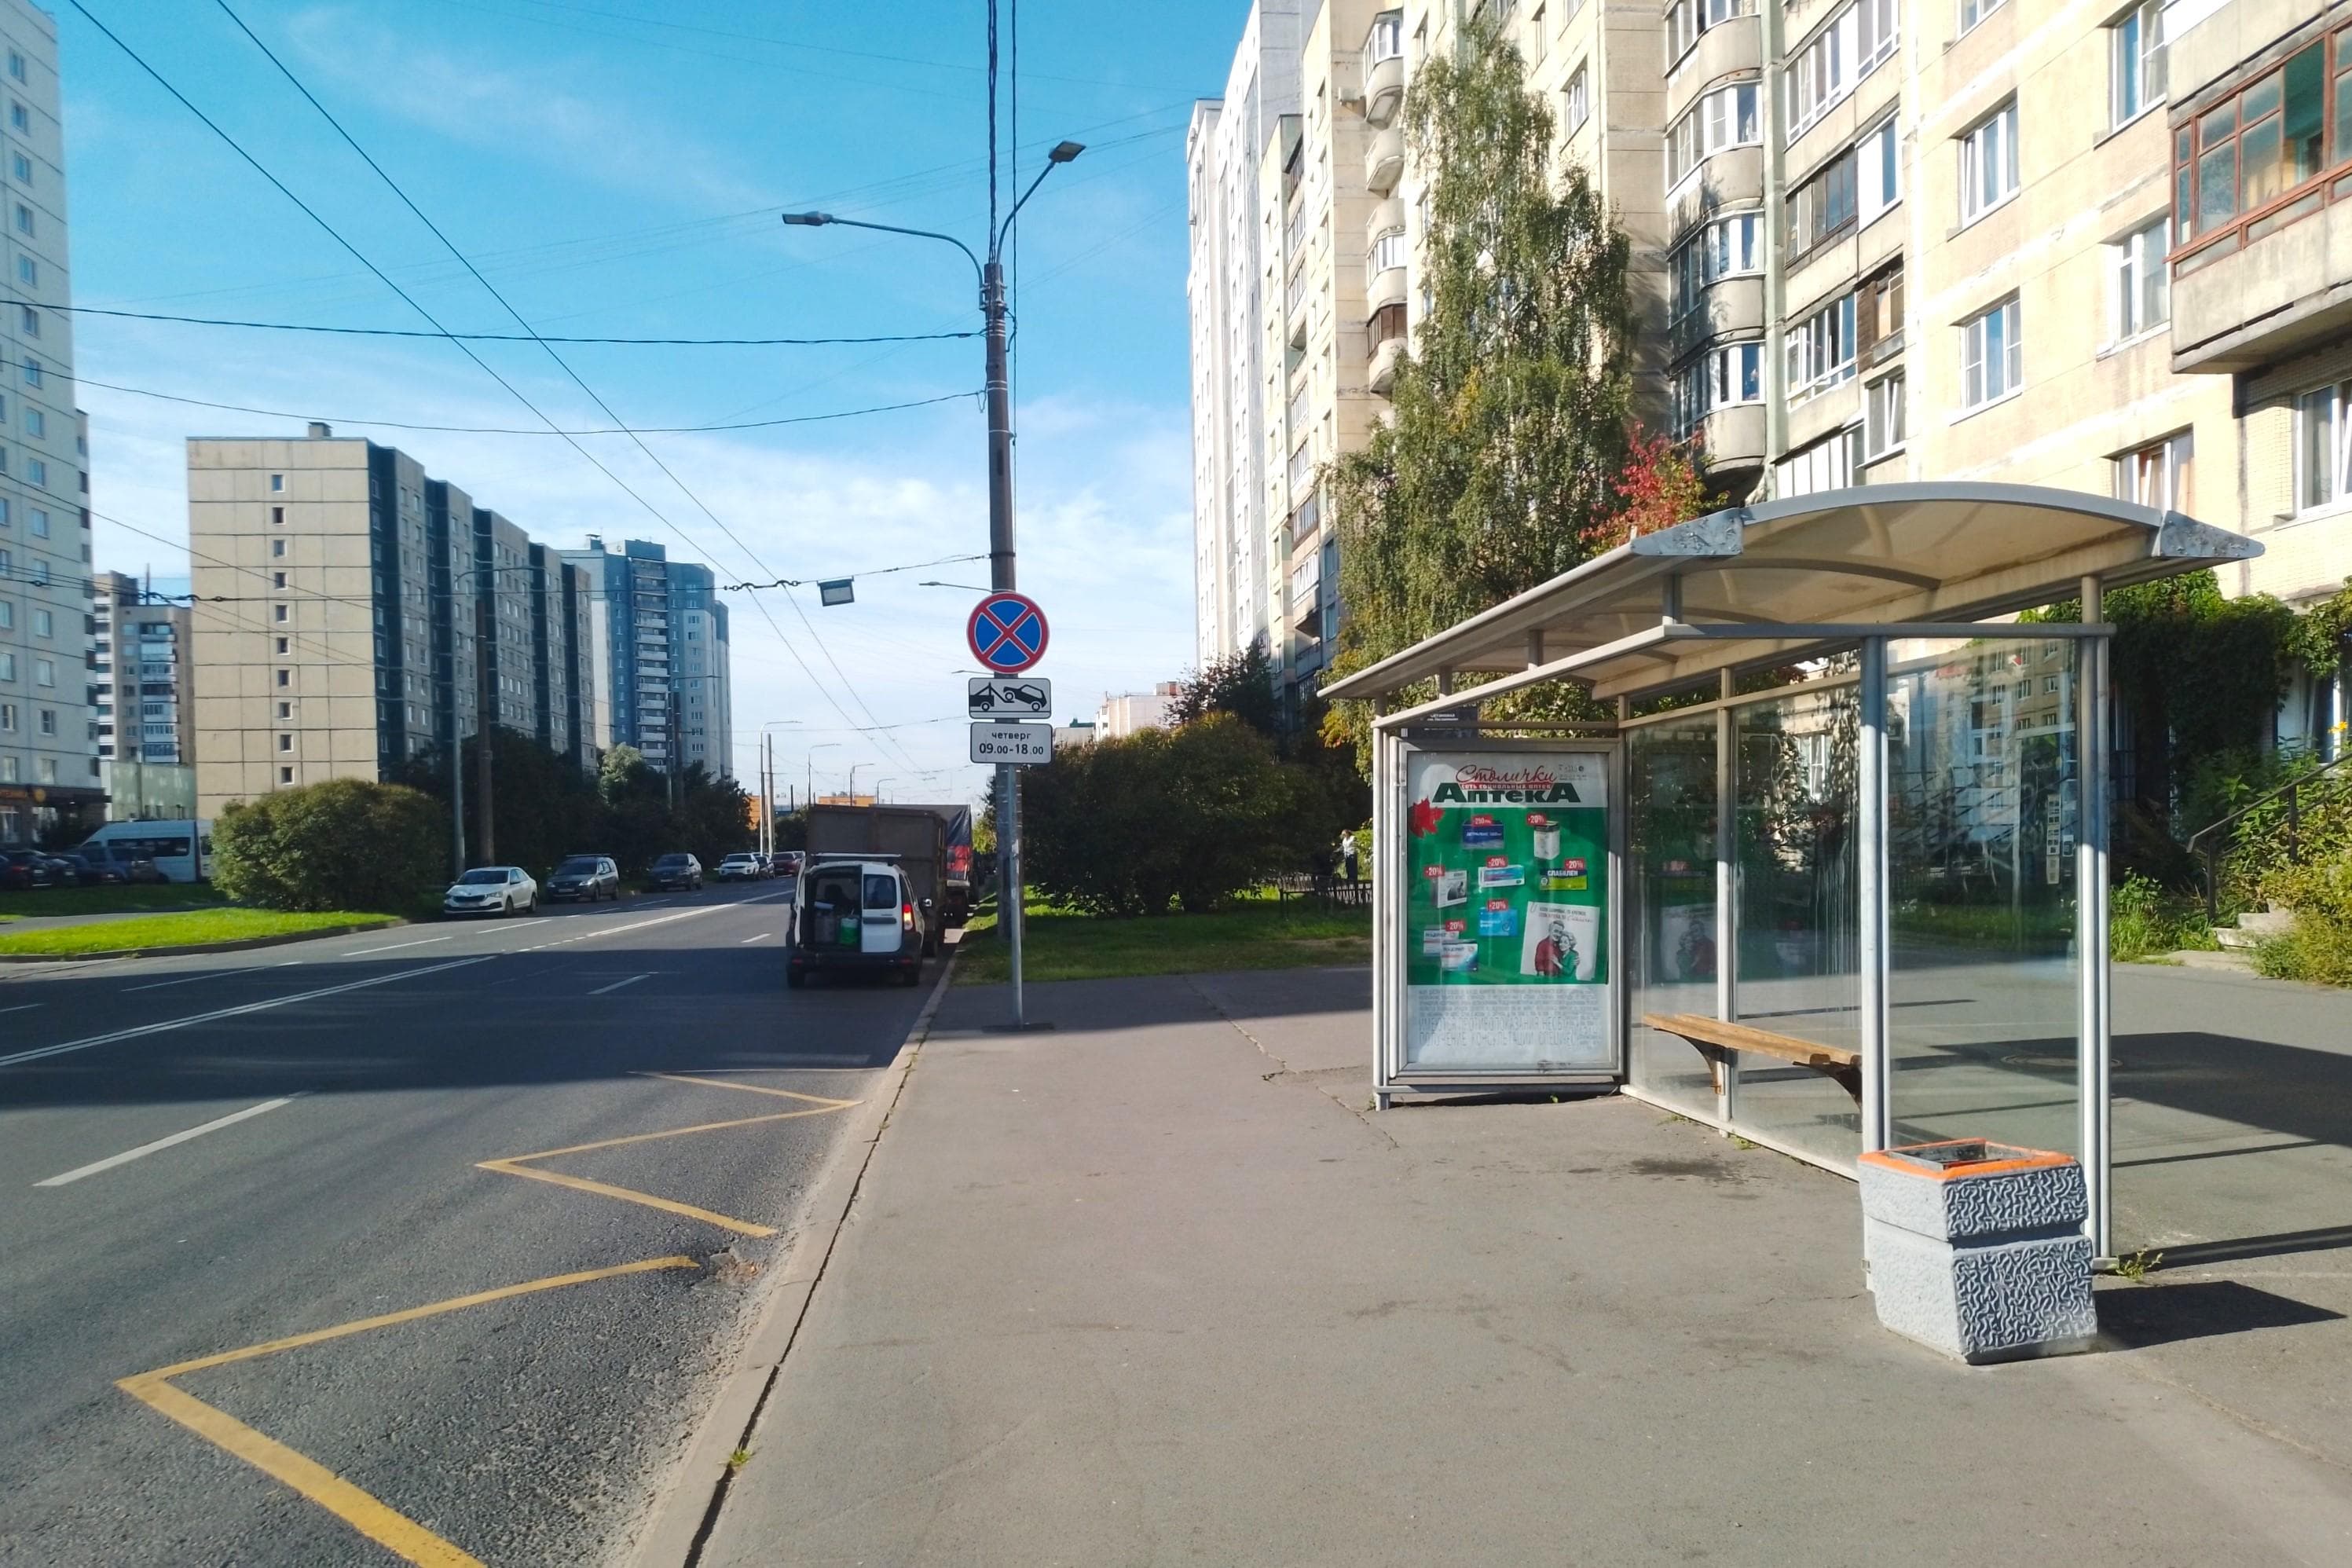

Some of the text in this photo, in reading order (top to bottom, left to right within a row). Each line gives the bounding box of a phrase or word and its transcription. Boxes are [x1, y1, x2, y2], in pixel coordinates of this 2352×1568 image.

[991, 732, 1031, 742] четверг
[1456, 764, 1558, 783] Столички
[1527, 815, 1545, 824] -20%
[1487, 857, 1506, 866] -20%
[1566, 860, 1584, 869] -20%
[1425, 866, 1443, 875] -20%
[1489, 900, 1507, 910] -20%
[1447, 921, 1464, 930] -20%
